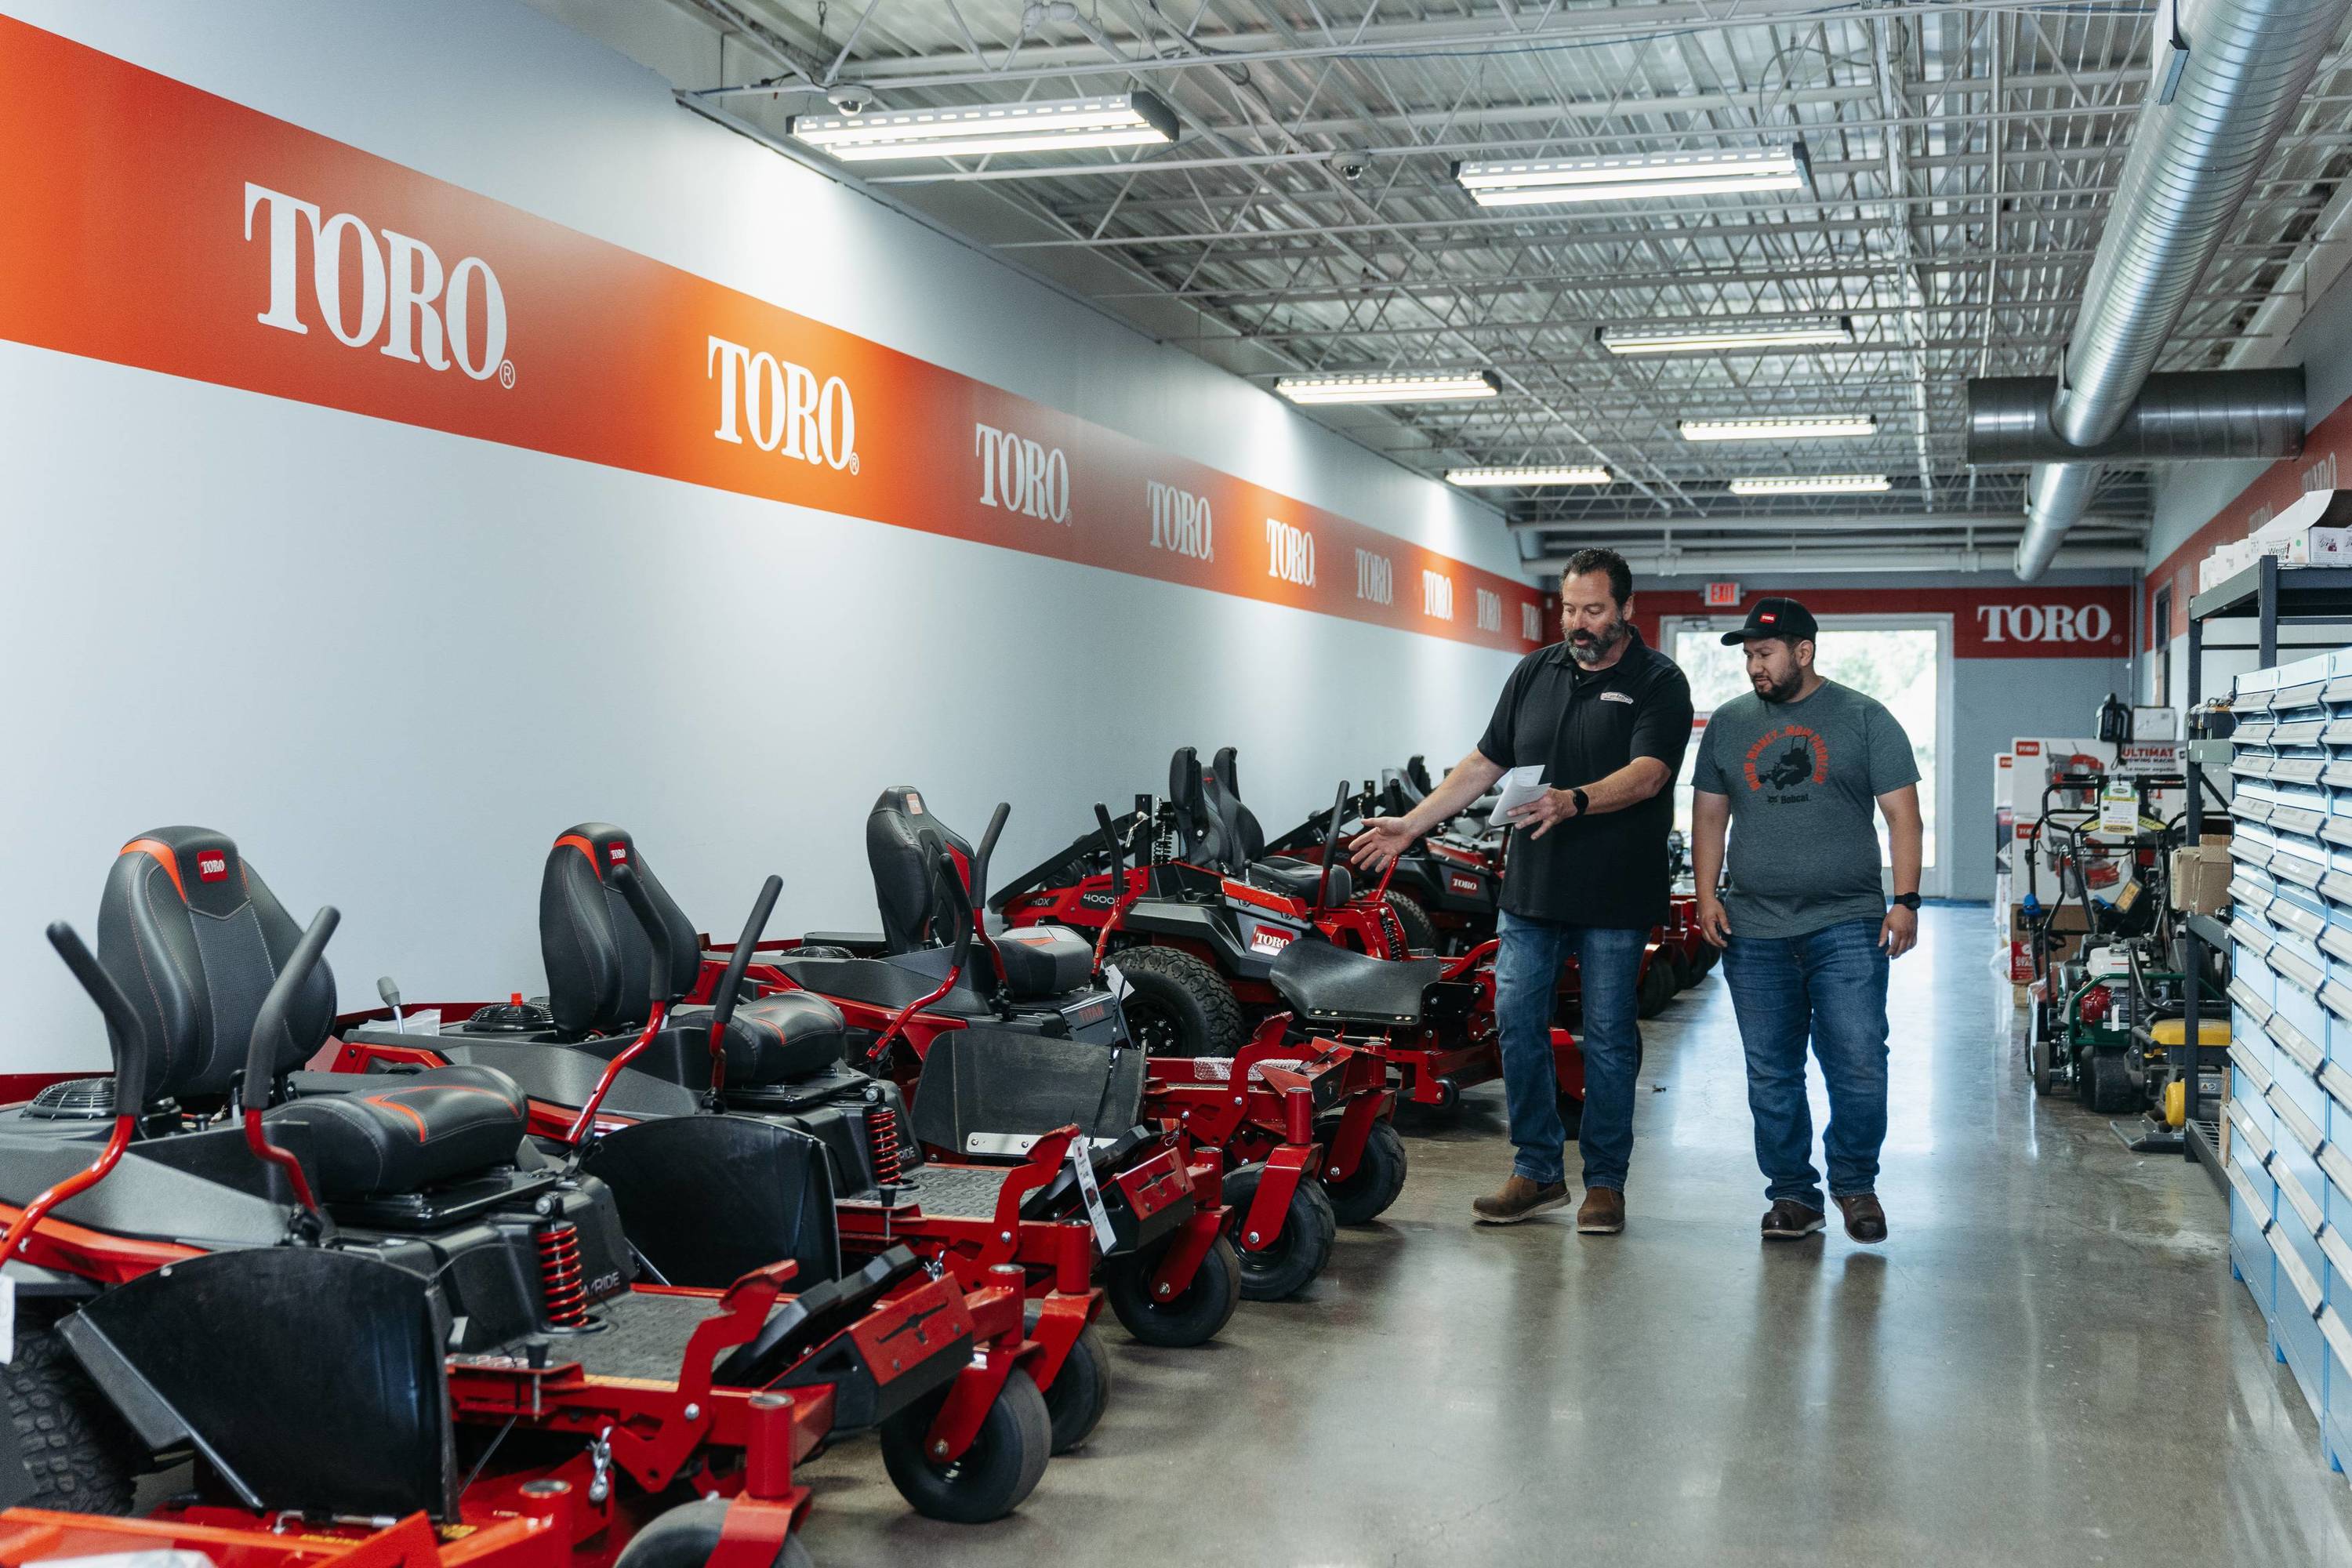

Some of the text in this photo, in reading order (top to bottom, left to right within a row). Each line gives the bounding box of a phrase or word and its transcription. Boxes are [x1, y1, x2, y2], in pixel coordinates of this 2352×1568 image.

[1266, 518, 1315, 586] TORO
[1355, 548, 1393, 605] TORO
[1711, 583, 1735, 603] EXIT
[2122, 747, 2175, 757] ULTIMAT
[1780, 793, 1809, 804] Bobcat
[610, 848, 626, 859] TORO
[201, 858, 225, 874] TORO
[1453, 878, 1477, 891] TORO
[1032, 898, 1051, 906] HDX
[1083, 893, 1115, 905] 4000
[1256, 932, 1290, 949] TORO
[1079, 1003, 1105, 1022] TITAN
